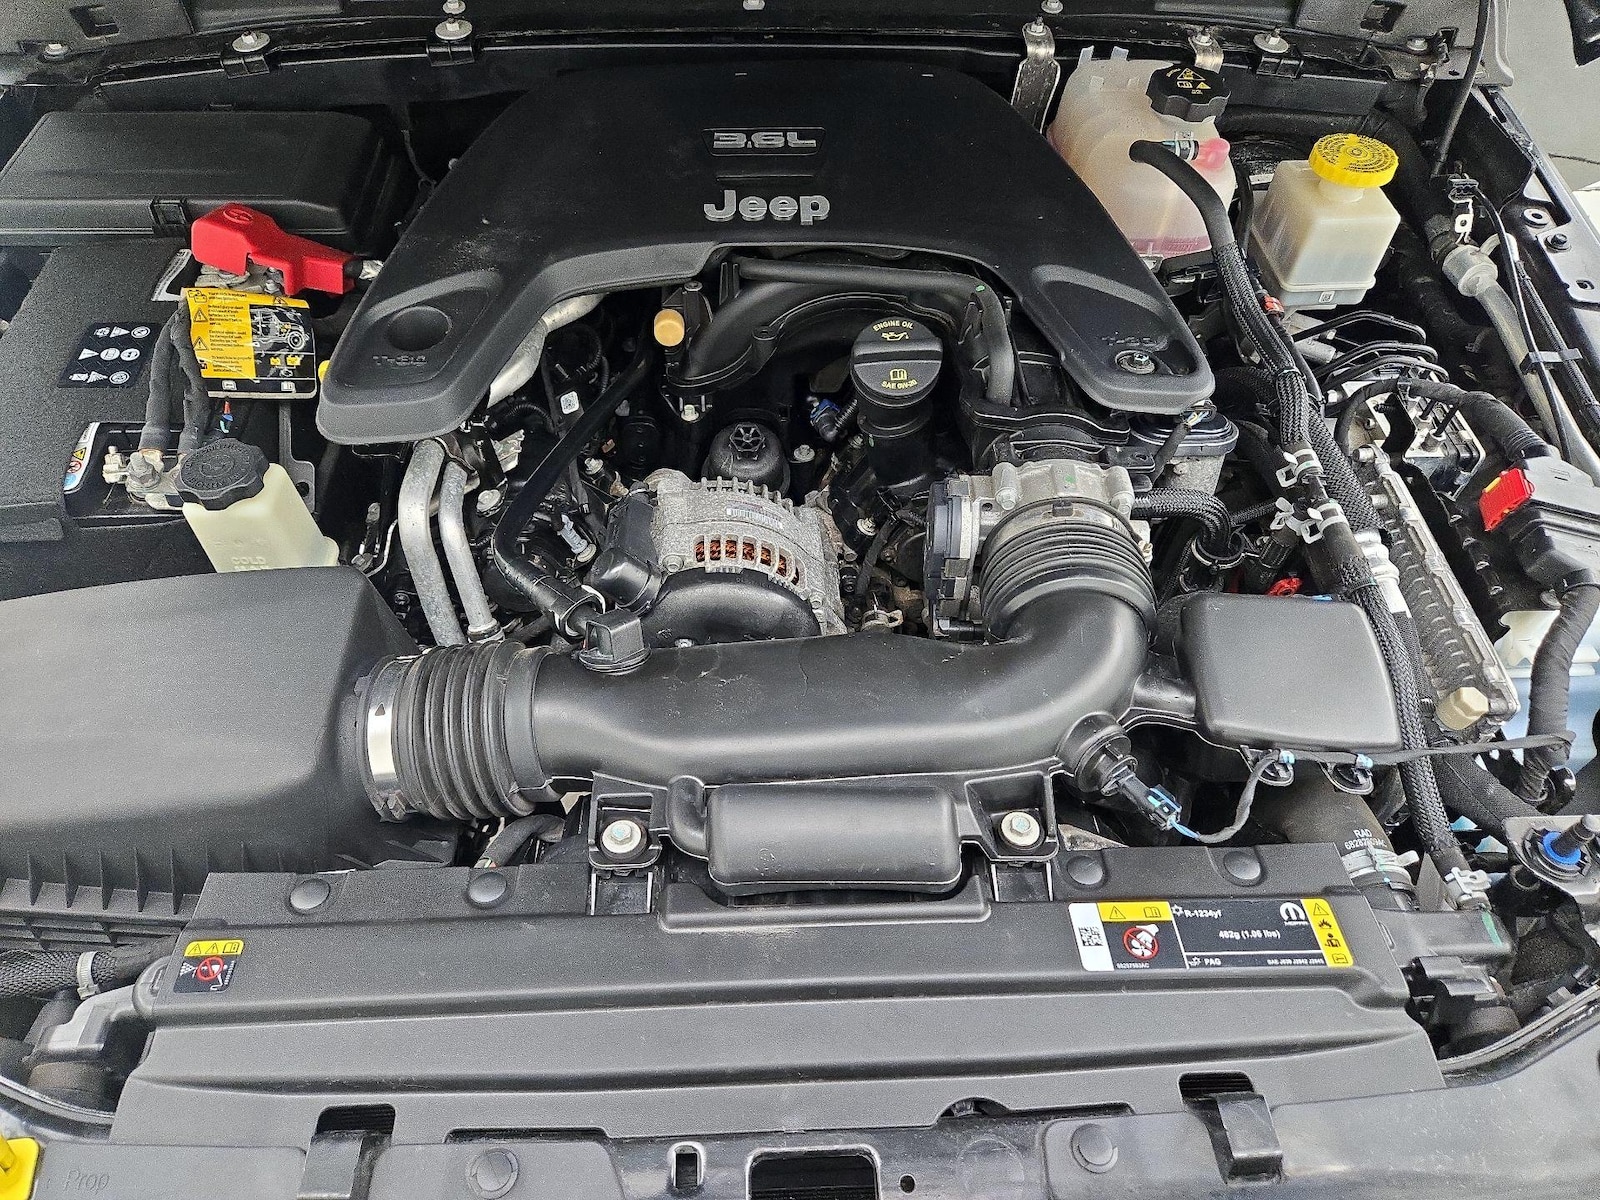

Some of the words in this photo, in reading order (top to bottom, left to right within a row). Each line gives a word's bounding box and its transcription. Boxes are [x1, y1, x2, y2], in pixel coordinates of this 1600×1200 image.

[713, 131, 817, 149] 3.6L
[703, 189, 831, 226] Jeep
[873, 320, 900, 331] ENGINE
[901, 320, 914, 330] OIL
[881, 380, 897, 390] SAE
[231, 556, 267, 565] COLD
[1353, 829, 1372, 838] RAD
[1183, 908, 1223, 920] R-1234yf
[1263, 928, 1281, 940] lbs)
[1204, 958, 1221, 966] PAG
[1266, 958, 1280, 966] SAE
